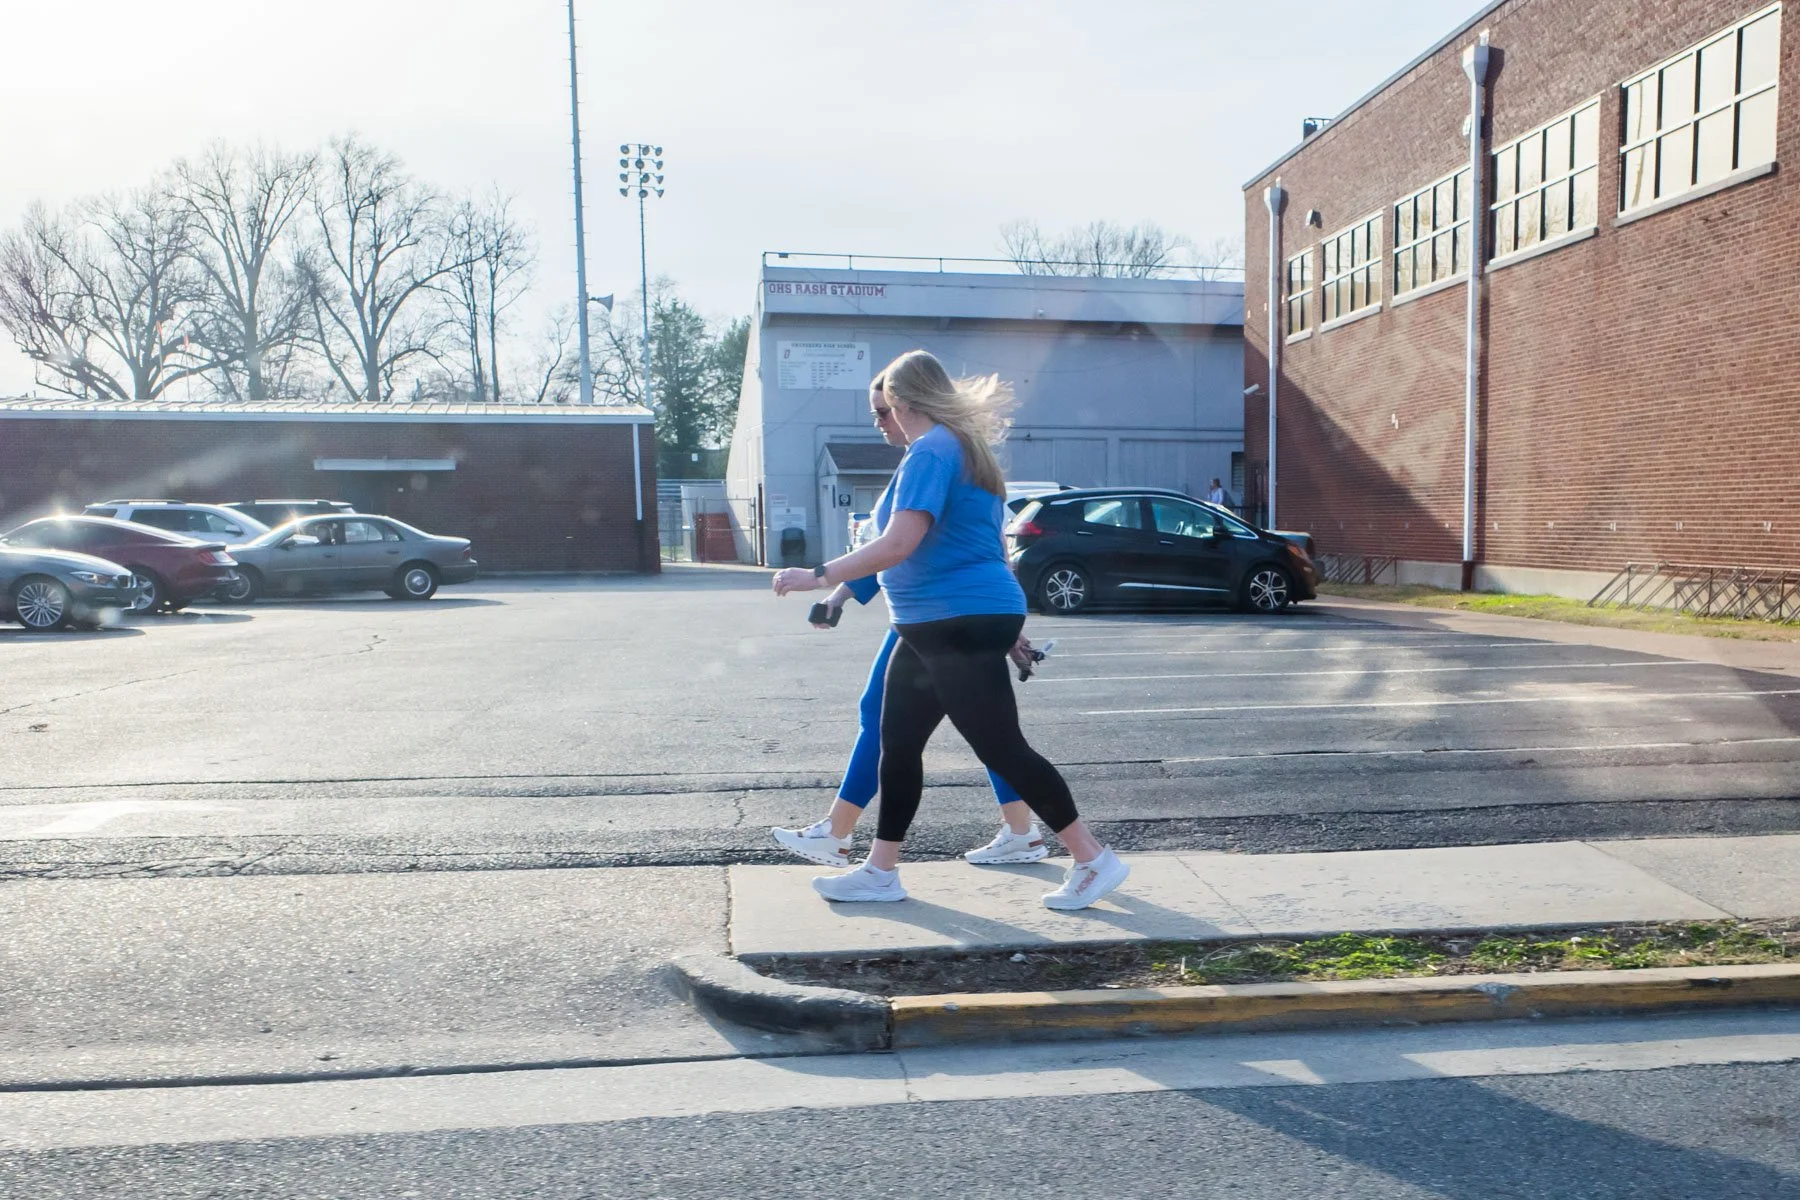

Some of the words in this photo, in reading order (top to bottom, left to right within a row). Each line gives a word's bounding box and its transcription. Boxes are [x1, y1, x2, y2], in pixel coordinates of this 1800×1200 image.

[769, 283, 792, 294] OHS
[796, 283, 827, 295] RASH
[830, 284, 884, 296] STADIUM
[1074, 870, 1098, 896] HOKA
